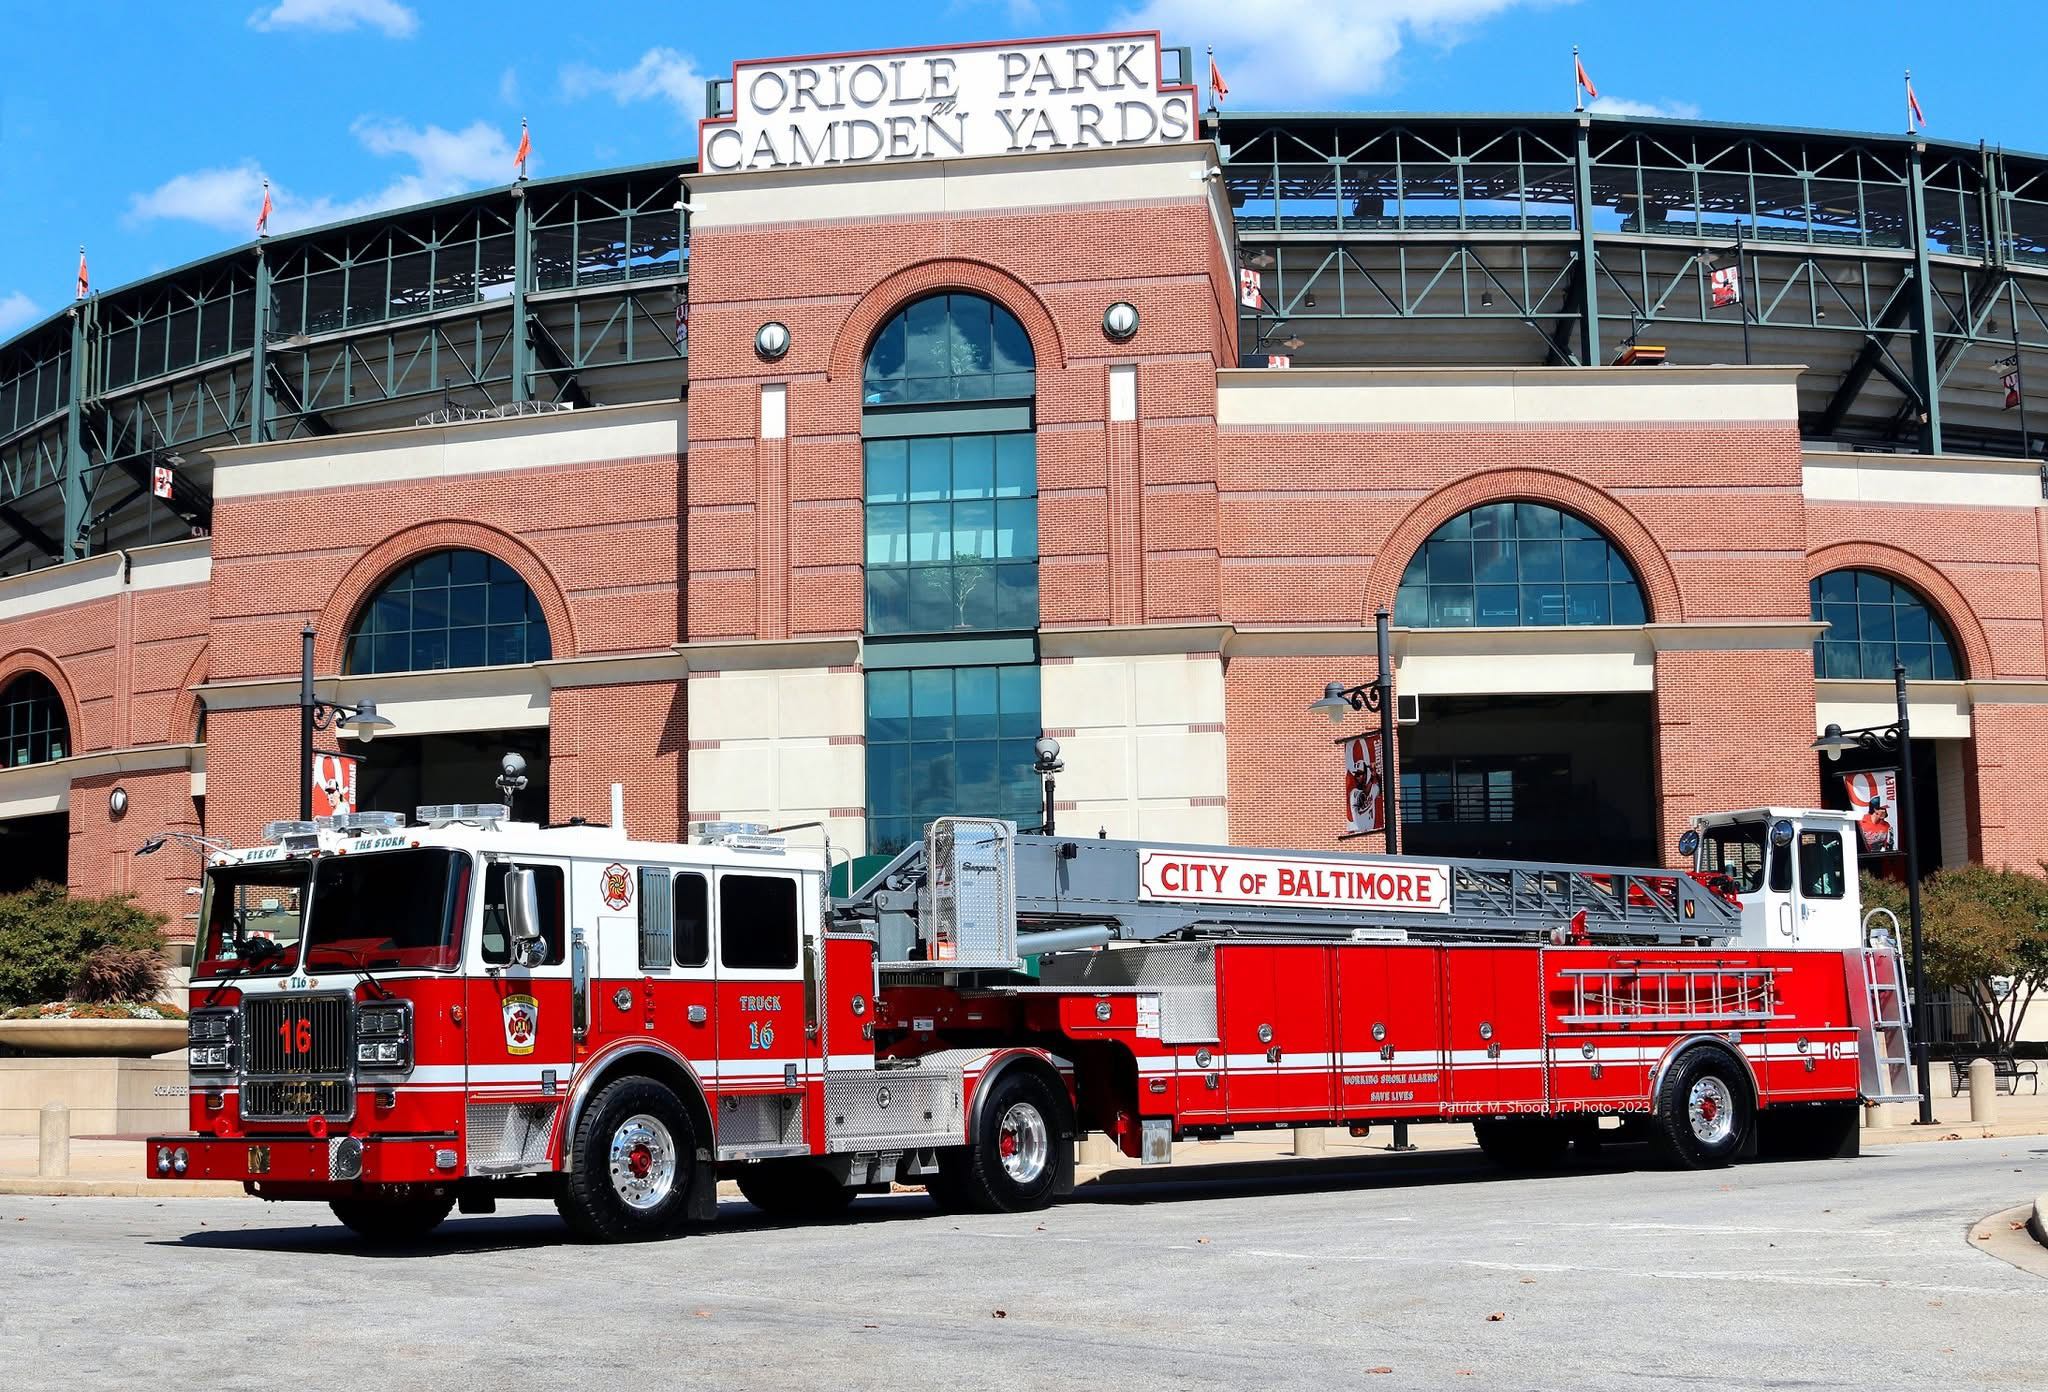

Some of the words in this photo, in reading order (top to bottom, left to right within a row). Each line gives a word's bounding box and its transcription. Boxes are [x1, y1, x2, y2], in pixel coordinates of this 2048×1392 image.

[749, 57, 960, 114] ORIOLE
[998, 44, 1149, 98] PARK
[932, 99, 957, 114] at
[706, 112, 969, 170] CAMDEN
[995, 98, 1189, 150] YARDS
[348, 763, 357, 805] GUNNAR
[1885, 775, 1896, 801] ADLEY
[246, 850, 264, 860] EYE
[265, 848, 279, 859] OF
[354, 840, 371, 851] THE
[374, 835, 407, 849] STORM
[1161, 862, 1229, 895] CITY
[1240, 872, 1268, 896] OF
[1278, 866, 1433, 902] BALTIMORE
[291, 976, 307, 989] T16
[739, 995, 782, 1011] TRUCK
[280, 1018, 312, 1054] 16
[749, 1020, 775, 1050] 16
[1825, 1041, 1841, 1060] 16
[1343, 1074, 1379, 1085] WORKING
[1380, 1073, 1407, 1084] SMOKE
[1407, 1072, 1438, 1083] ALARMS
[1370, 1091, 1390, 1102] SAVE
[1391, 1090, 1414, 1101] LIVES
